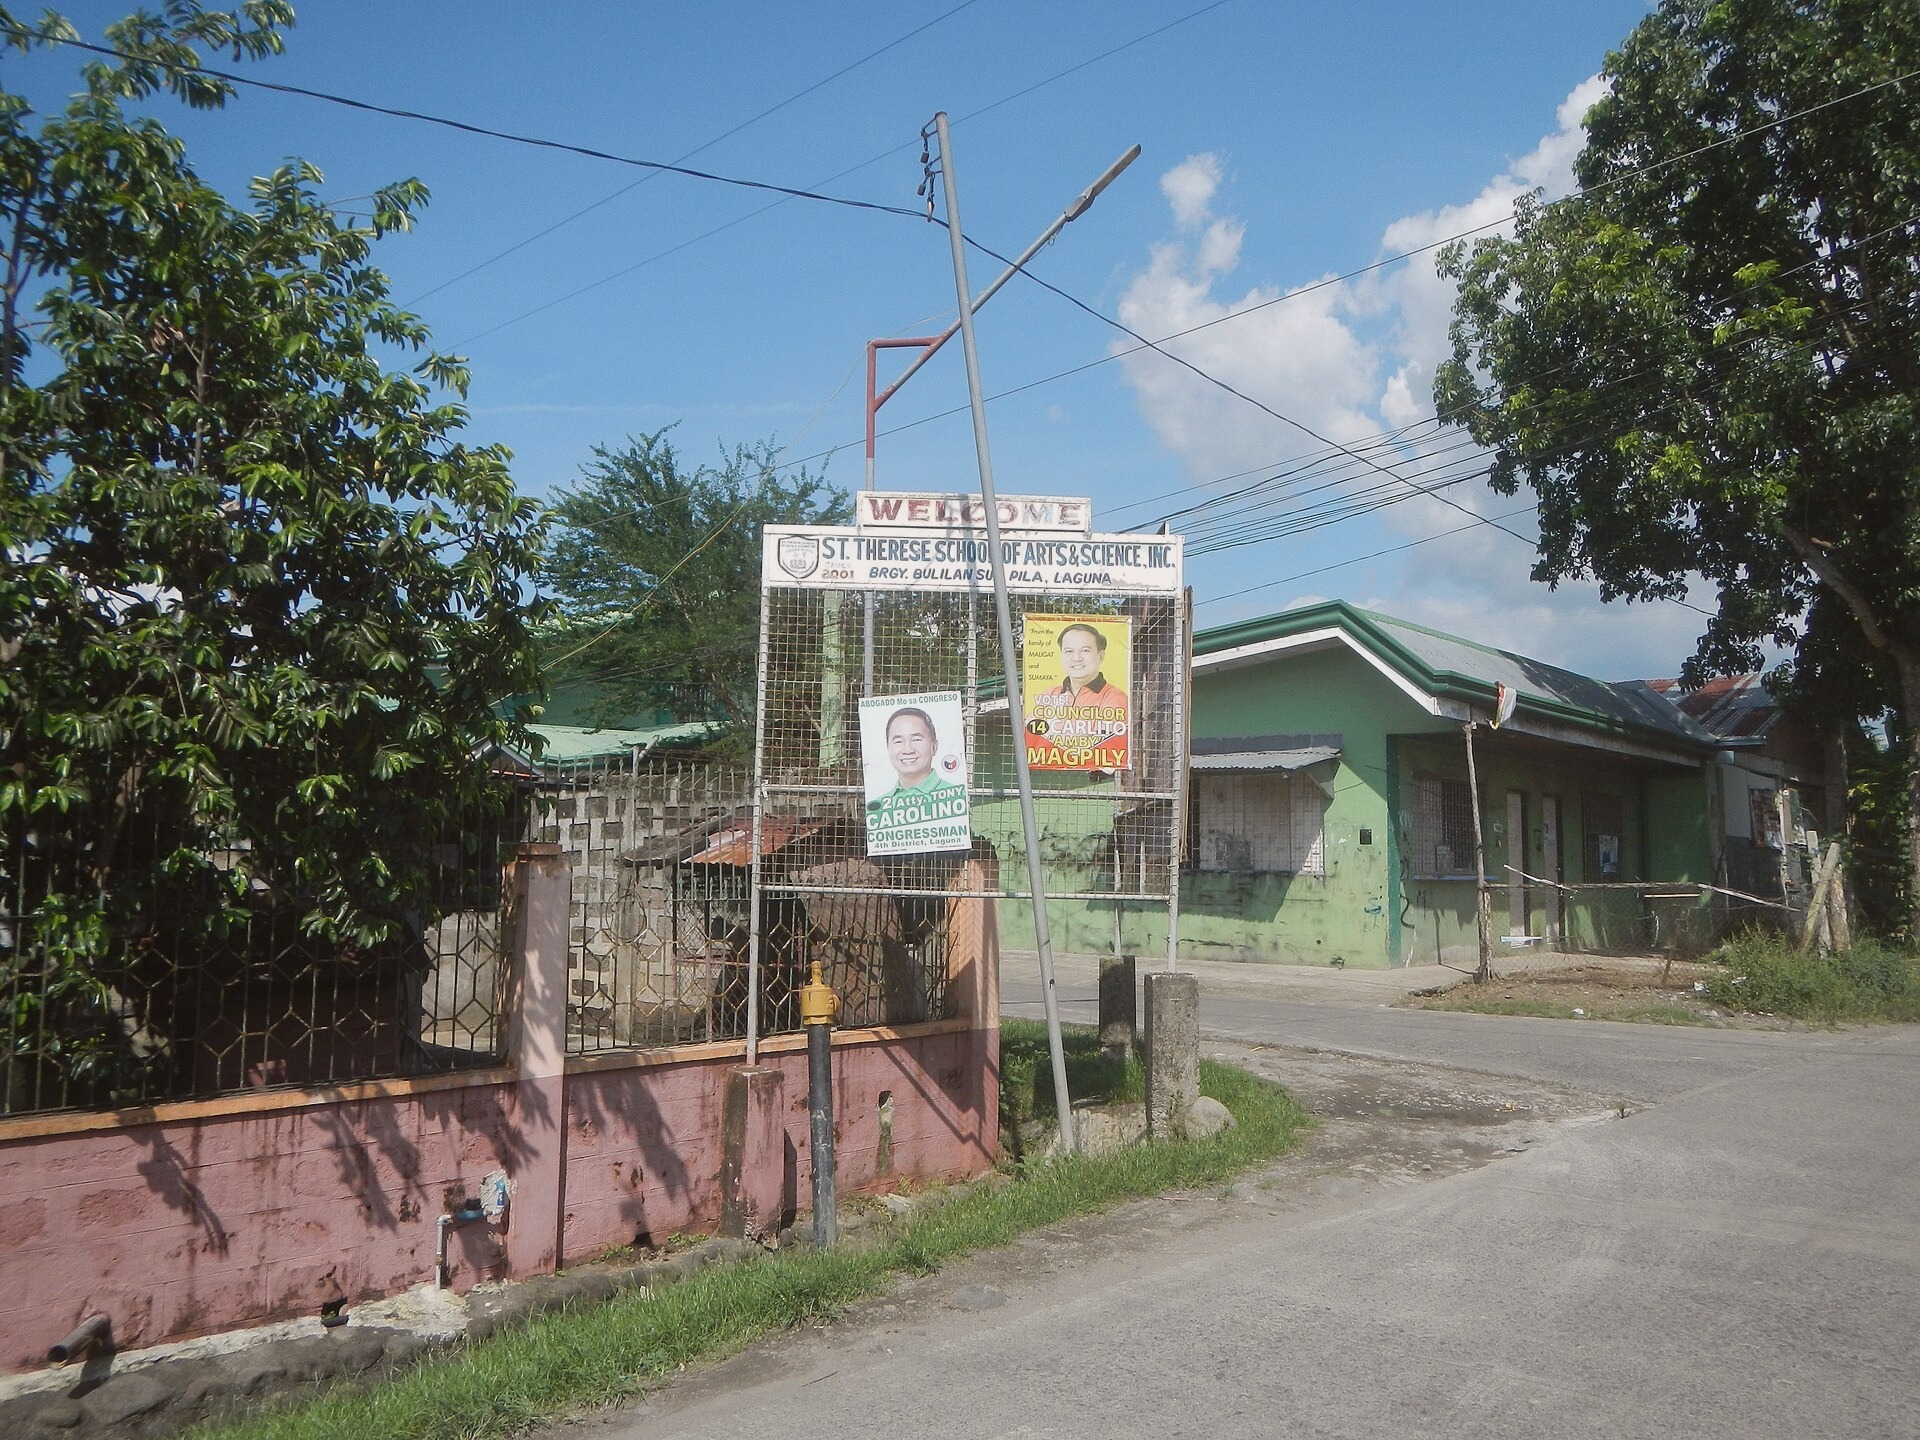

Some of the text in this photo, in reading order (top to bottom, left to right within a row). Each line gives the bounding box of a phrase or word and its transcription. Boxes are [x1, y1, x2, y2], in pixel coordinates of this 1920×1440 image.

[868, 499, 1081, 525] WELCOME
[853, 537, 932, 562] THERESE
[1001, 541, 1021, 565] OF
[821, 569, 855, 579] 2001
[868, 566, 1112, 585] BRGY. BULILAN SU PILA, LAGUNA
[860, 698, 896, 708] ABOGADO
[918, 693, 958, 704] CONGRESO
[1033, 705, 1125, 720] COUNCILOR
[1029, 719, 1127, 736] 14 CARLITO
[1027, 747, 1125, 766] MAGPILY
[881, 786, 964, 810] 2 Atty. TONY
[866, 798, 966, 830] CAROLINO
[867, 825, 967, 843] CONGRESSMAN
[874, 841, 889, 849] 4th
[891, 839, 928, 848] District,
[929, 837, 961, 846] Laguna
